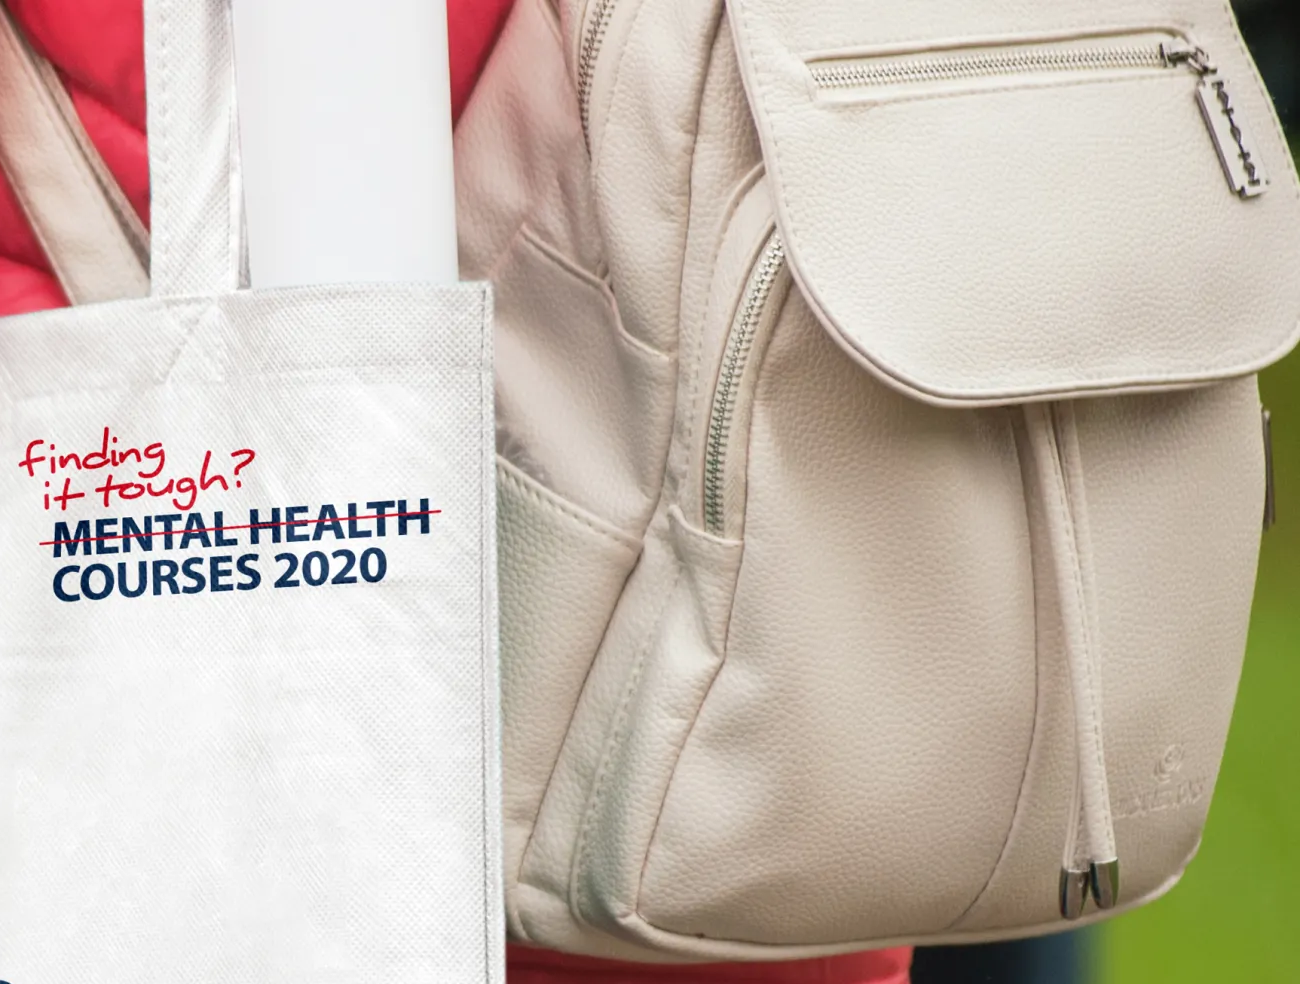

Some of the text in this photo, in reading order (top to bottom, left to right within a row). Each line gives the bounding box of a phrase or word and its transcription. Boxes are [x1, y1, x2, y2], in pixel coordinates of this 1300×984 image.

[18, 426, 166, 479] finding
[43, 448, 257, 511] it tough?
[53, 498, 431, 558] MENTAL HEALTH
[53, 546, 388, 603] COURSES 2020
